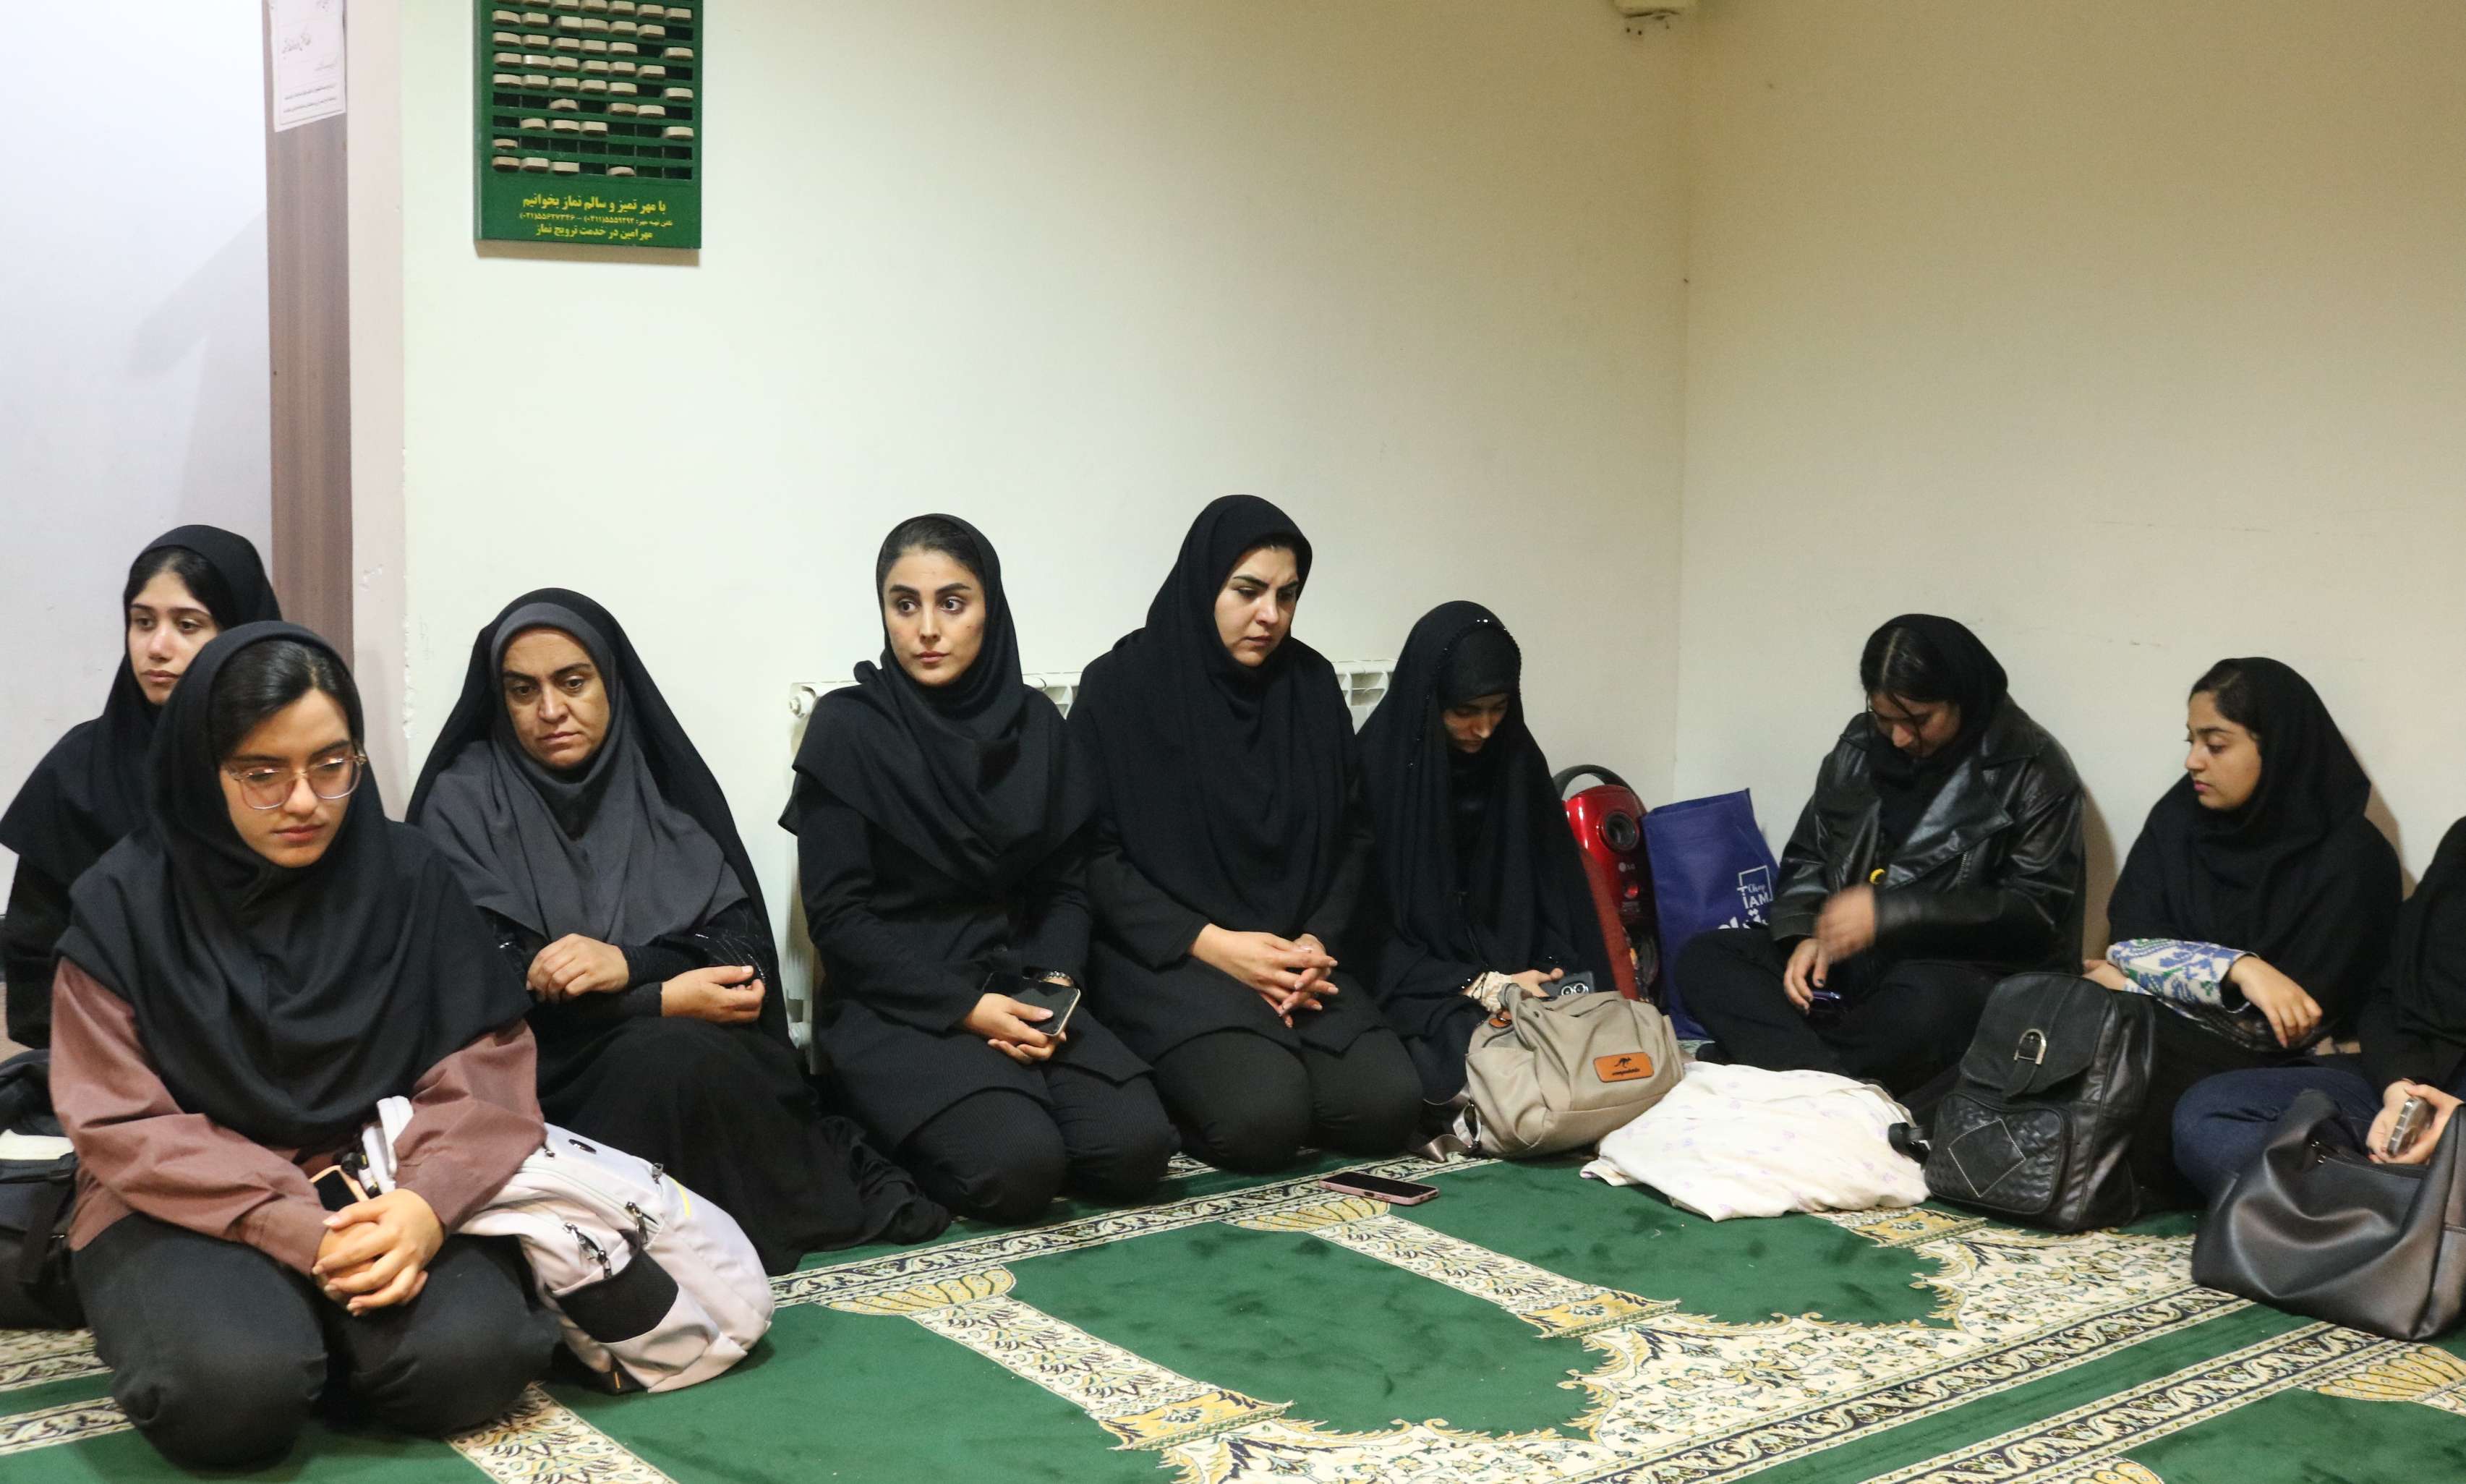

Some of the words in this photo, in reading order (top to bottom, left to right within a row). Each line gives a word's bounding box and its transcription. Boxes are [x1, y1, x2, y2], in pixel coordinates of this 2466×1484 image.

[523, 192, 560, 210] بخوانیم
[562, 195, 582, 210] نماز
[584, 196, 607, 210] سالم
[618, 199, 637, 213] تمیز
[608, 202, 615, 213] و
[639, 203, 657, 215] مهر
[659, 200, 666, 215] با
[536, 223, 552, 236] نماز
[554, 225, 578, 237] ترویج
[579, 226, 607, 236] خدمت
[608, 229, 618, 239] در
[620, 228, 639, 240] امین
[639, 231, 654, 241] مهر
